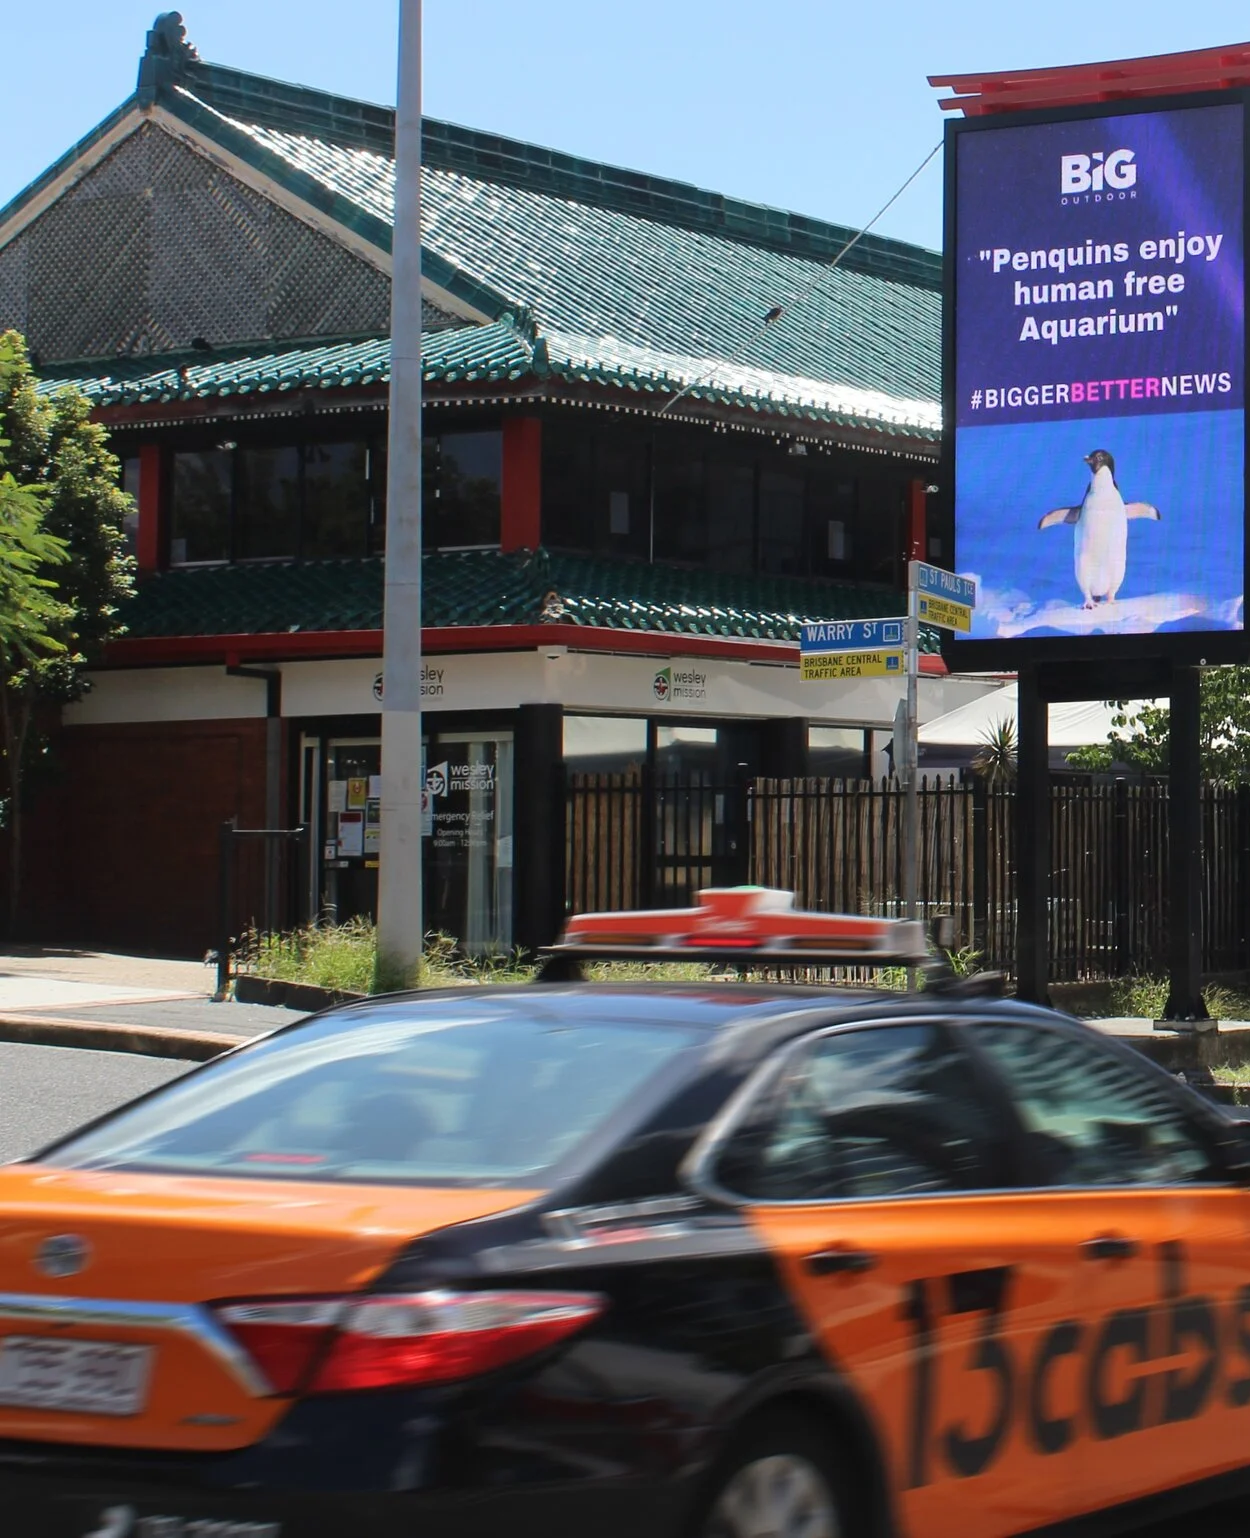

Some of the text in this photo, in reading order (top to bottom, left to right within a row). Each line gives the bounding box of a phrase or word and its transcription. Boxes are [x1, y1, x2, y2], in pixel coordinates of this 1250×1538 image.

[1061, 191, 1138, 206] OUTDOOR
[1139, 231, 1223, 262] enjoy
[1014, 271, 1185, 305] human free
[1019, 305, 1178, 345] Aquarium"
[971, 372, 1232, 409] #BIGGERBETTERNEWS
[929, 568, 974, 597] ST PAULS TCE
[928, 598, 968, 618] BRISBANE CENTRAL
[928, 609, 958, 626] TRAFFIC AREA
[807, 622, 878, 642] WARRY ST
[804, 654, 882, 668] BRISBANE CENTRAL
[420, 664, 444, 683] sley
[673, 668, 707, 687] wesley
[804, 666, 862, 679] TRAFFIC AREA
[420, 685, 444, 695] sion
[673, 687, 706, 698] mission
[450, 760, 494, 778] wesley
[450, 779, 494, 790] mission
